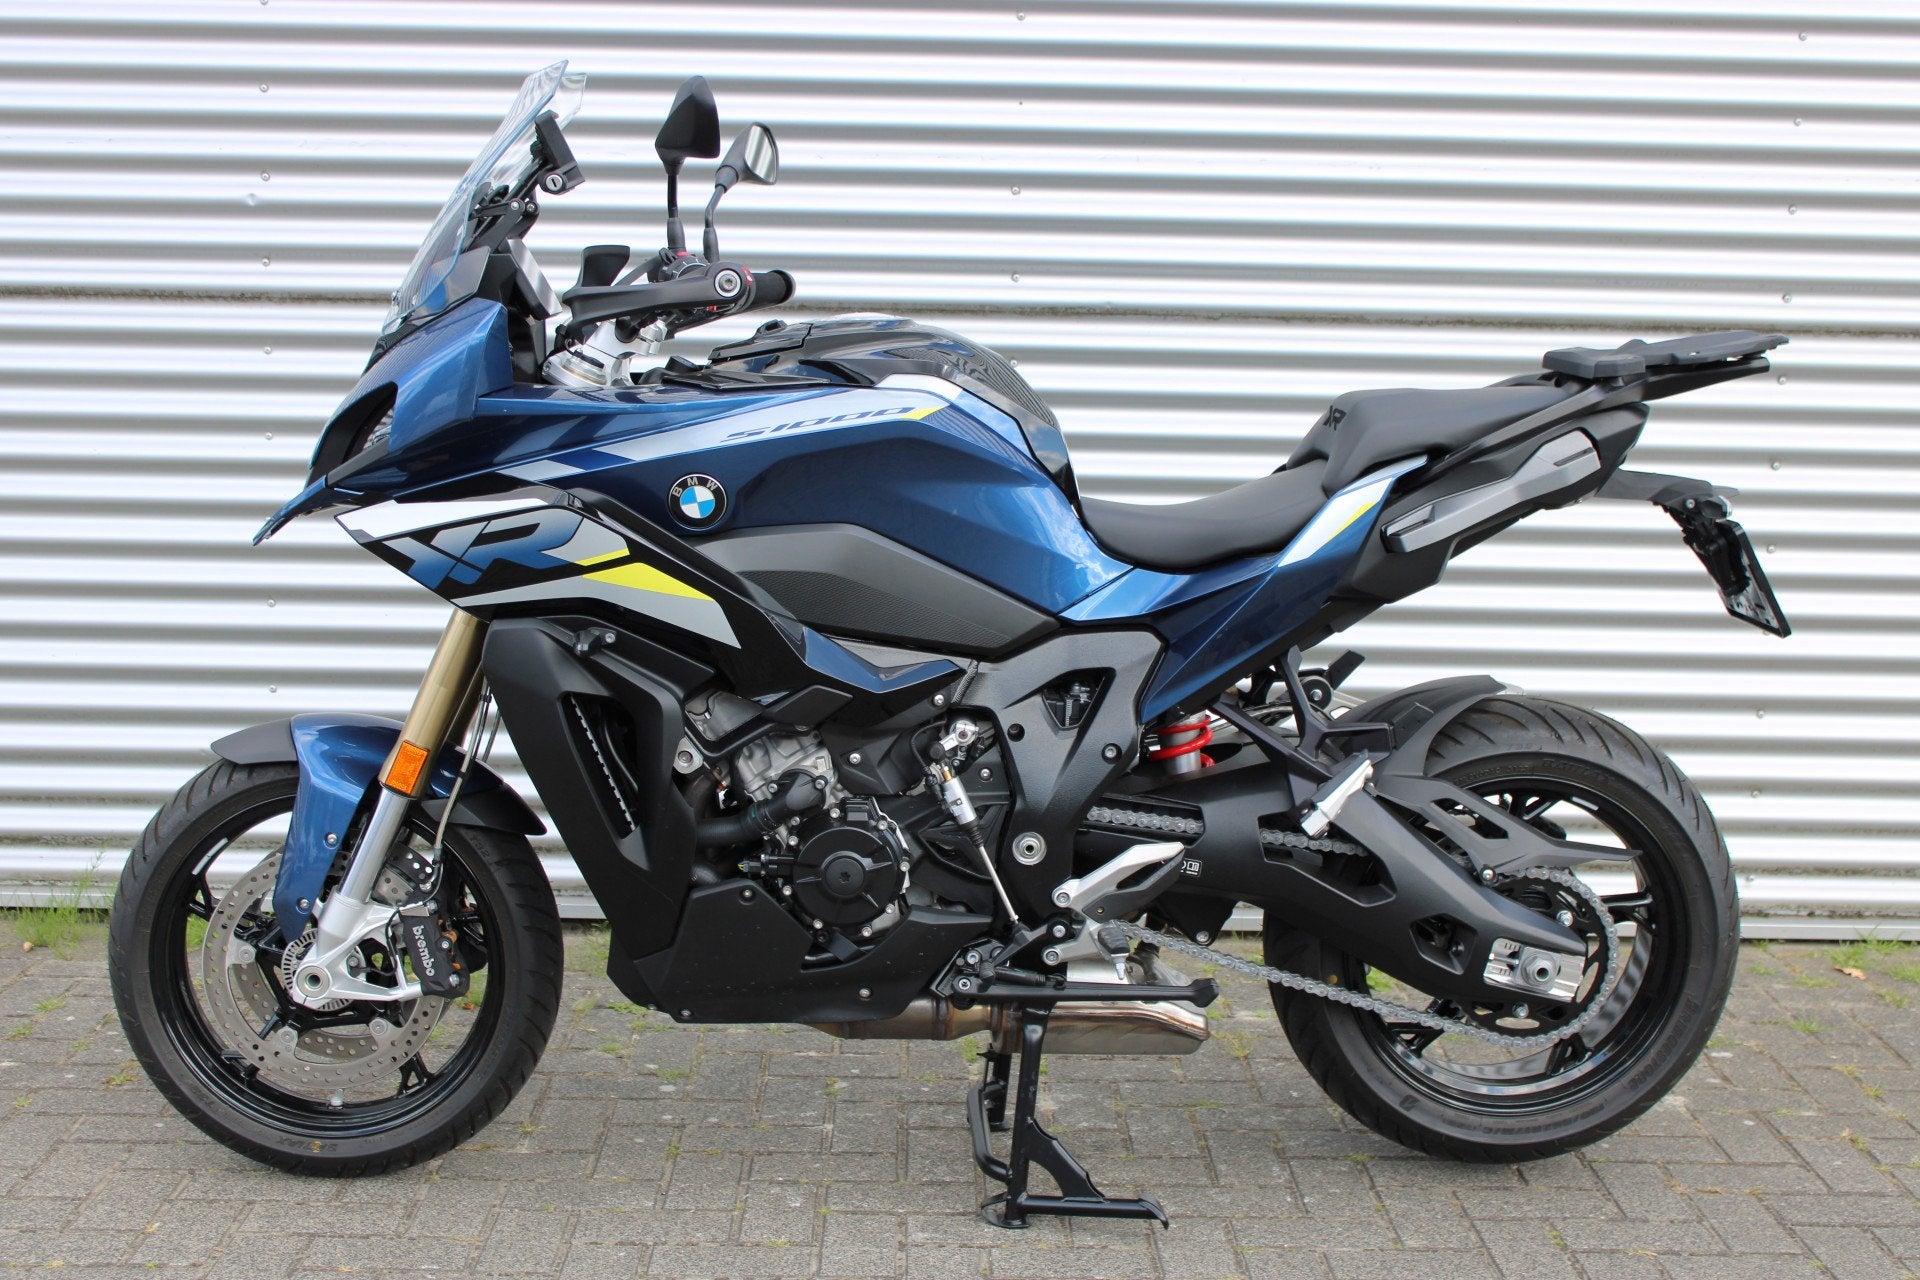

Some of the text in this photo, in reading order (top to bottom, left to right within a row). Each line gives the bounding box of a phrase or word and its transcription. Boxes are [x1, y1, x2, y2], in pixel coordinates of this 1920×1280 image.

[721, 407, 916, 443] S1000
[1323, 405, 1347, 431] XR
[672, 477, 718, 497] BMW
[382, 508, 585, 590] XR
[412, 925, 435, 977] brembo
